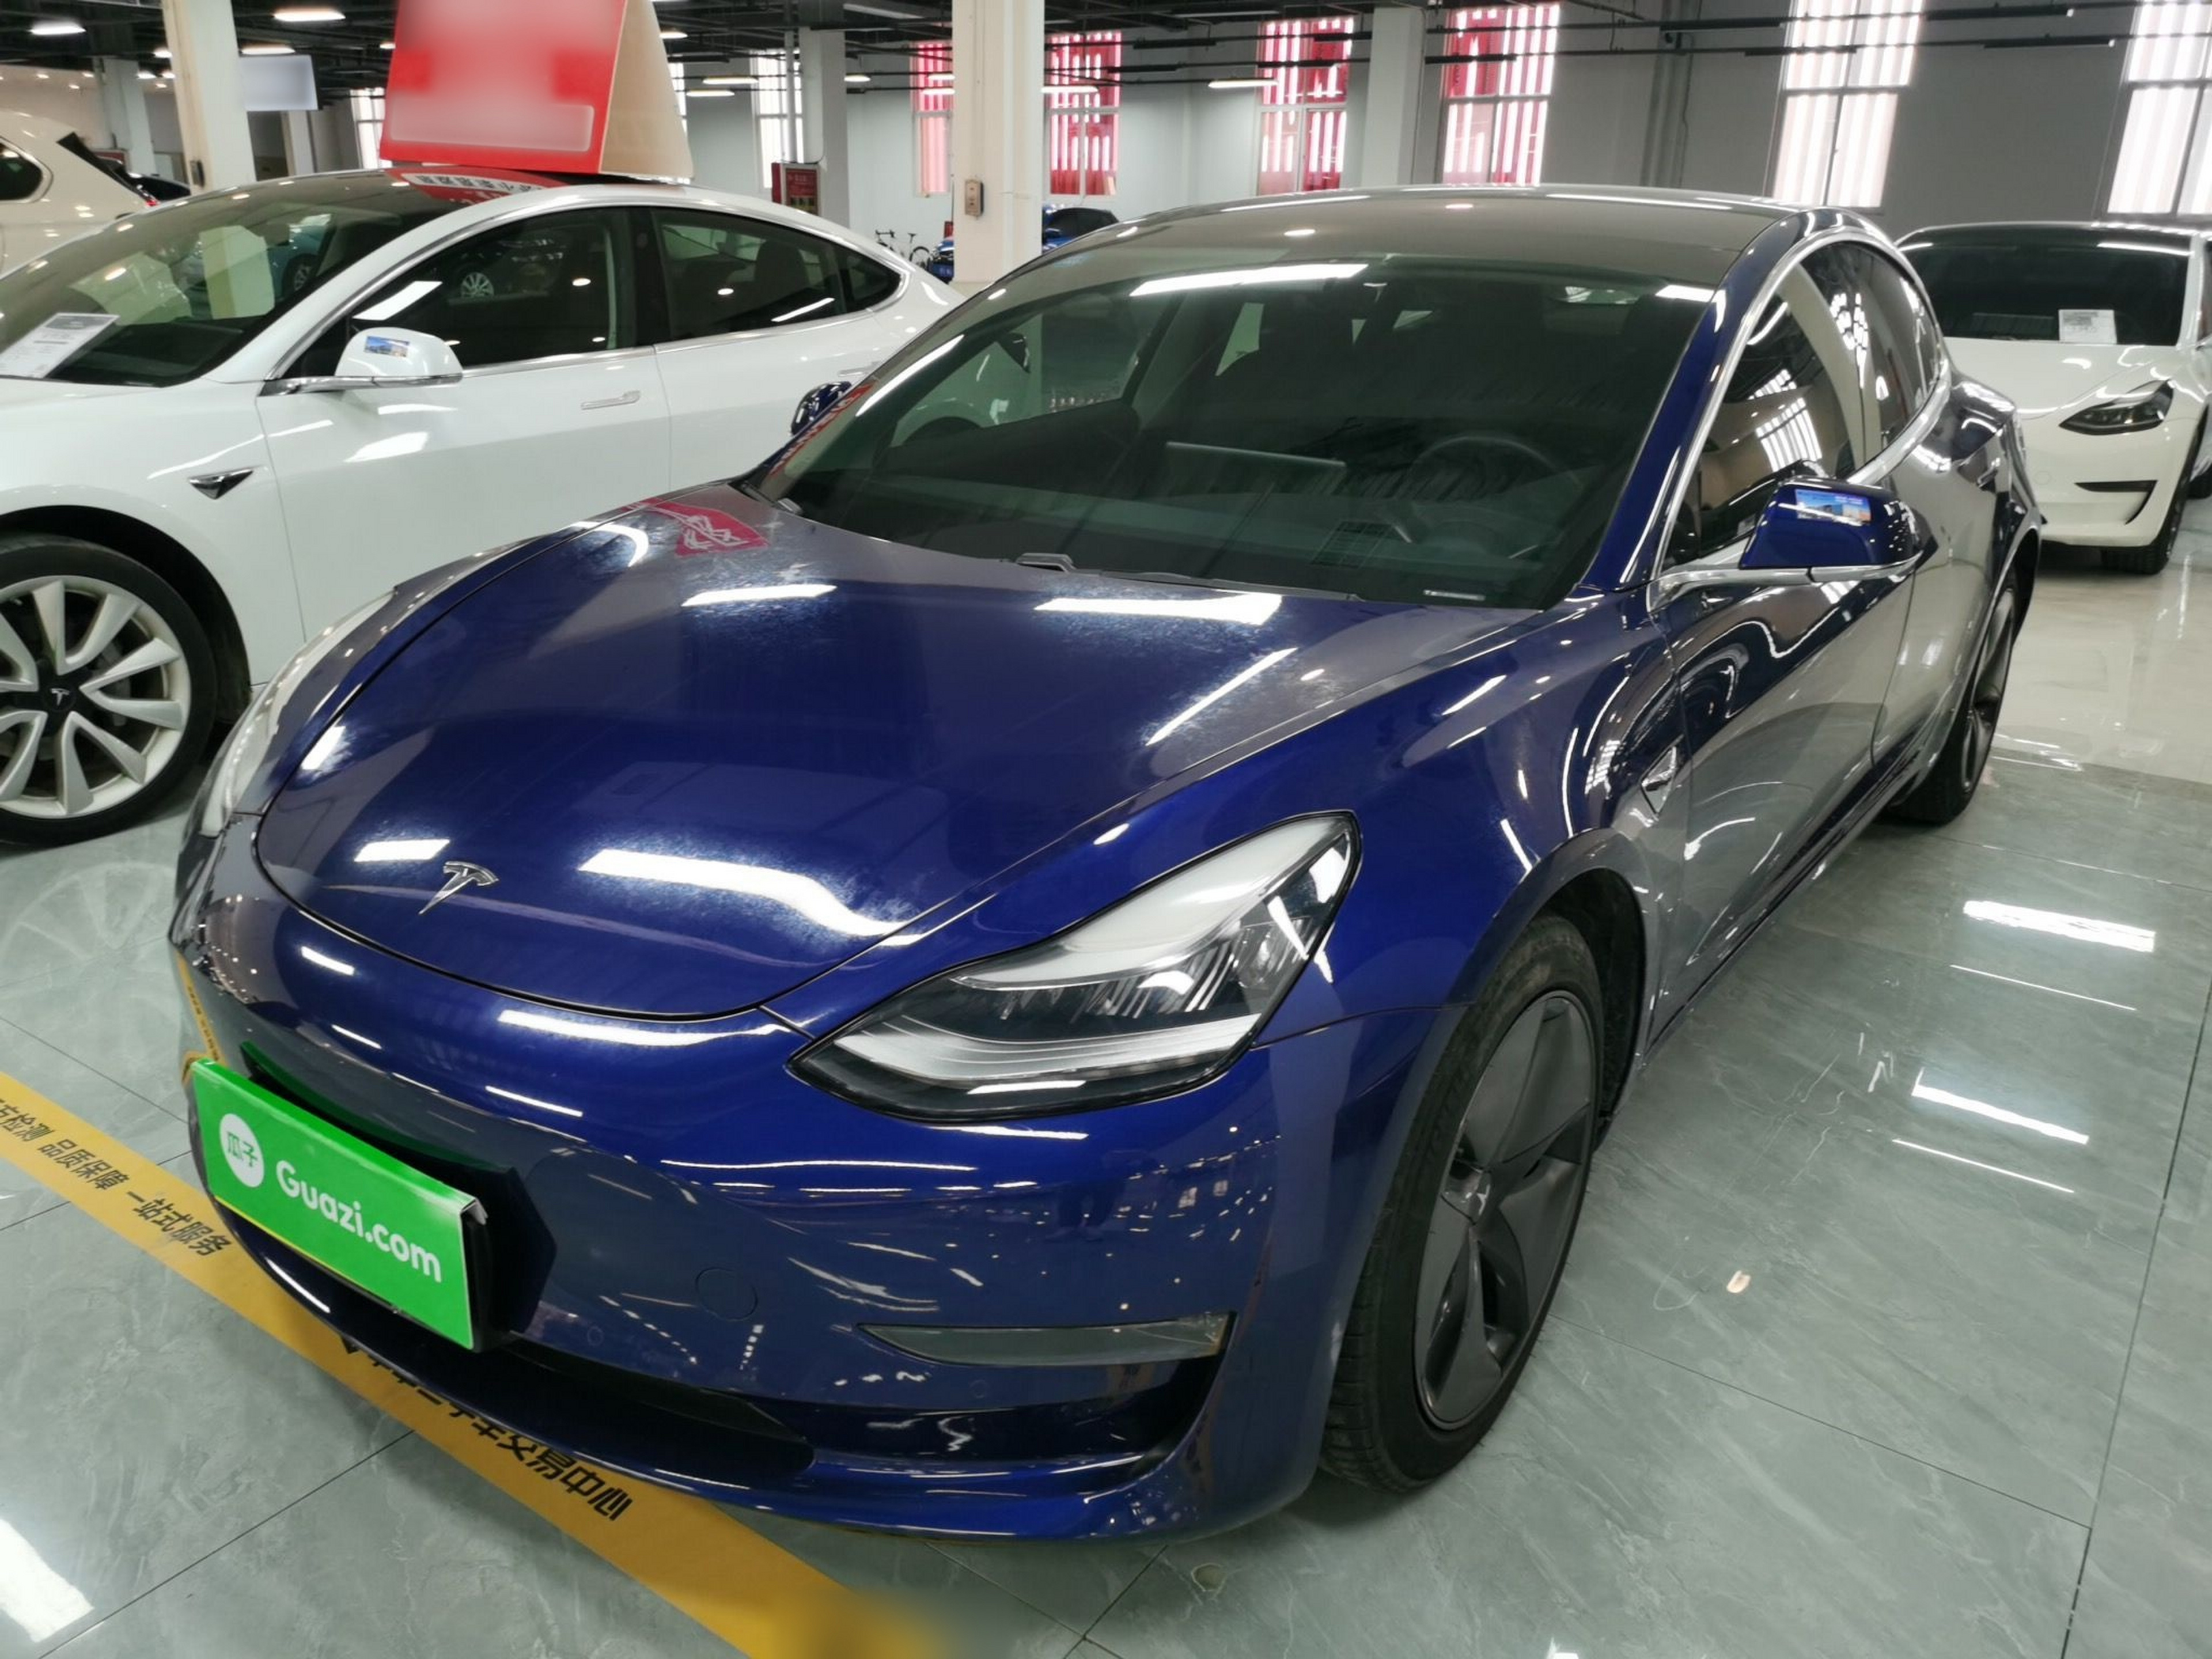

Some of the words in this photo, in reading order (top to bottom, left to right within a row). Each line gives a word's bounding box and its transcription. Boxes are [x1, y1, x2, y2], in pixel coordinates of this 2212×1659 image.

[0, 1099, 55, 1142] 方检测
[37, 1139, 130, 1190] 品质保障
[127, 1191, 232, 1256] 一站式服务
[228, 1132, 258, 1167] 瓜子
[275, 1160, 442, 1283] Guazi.com
